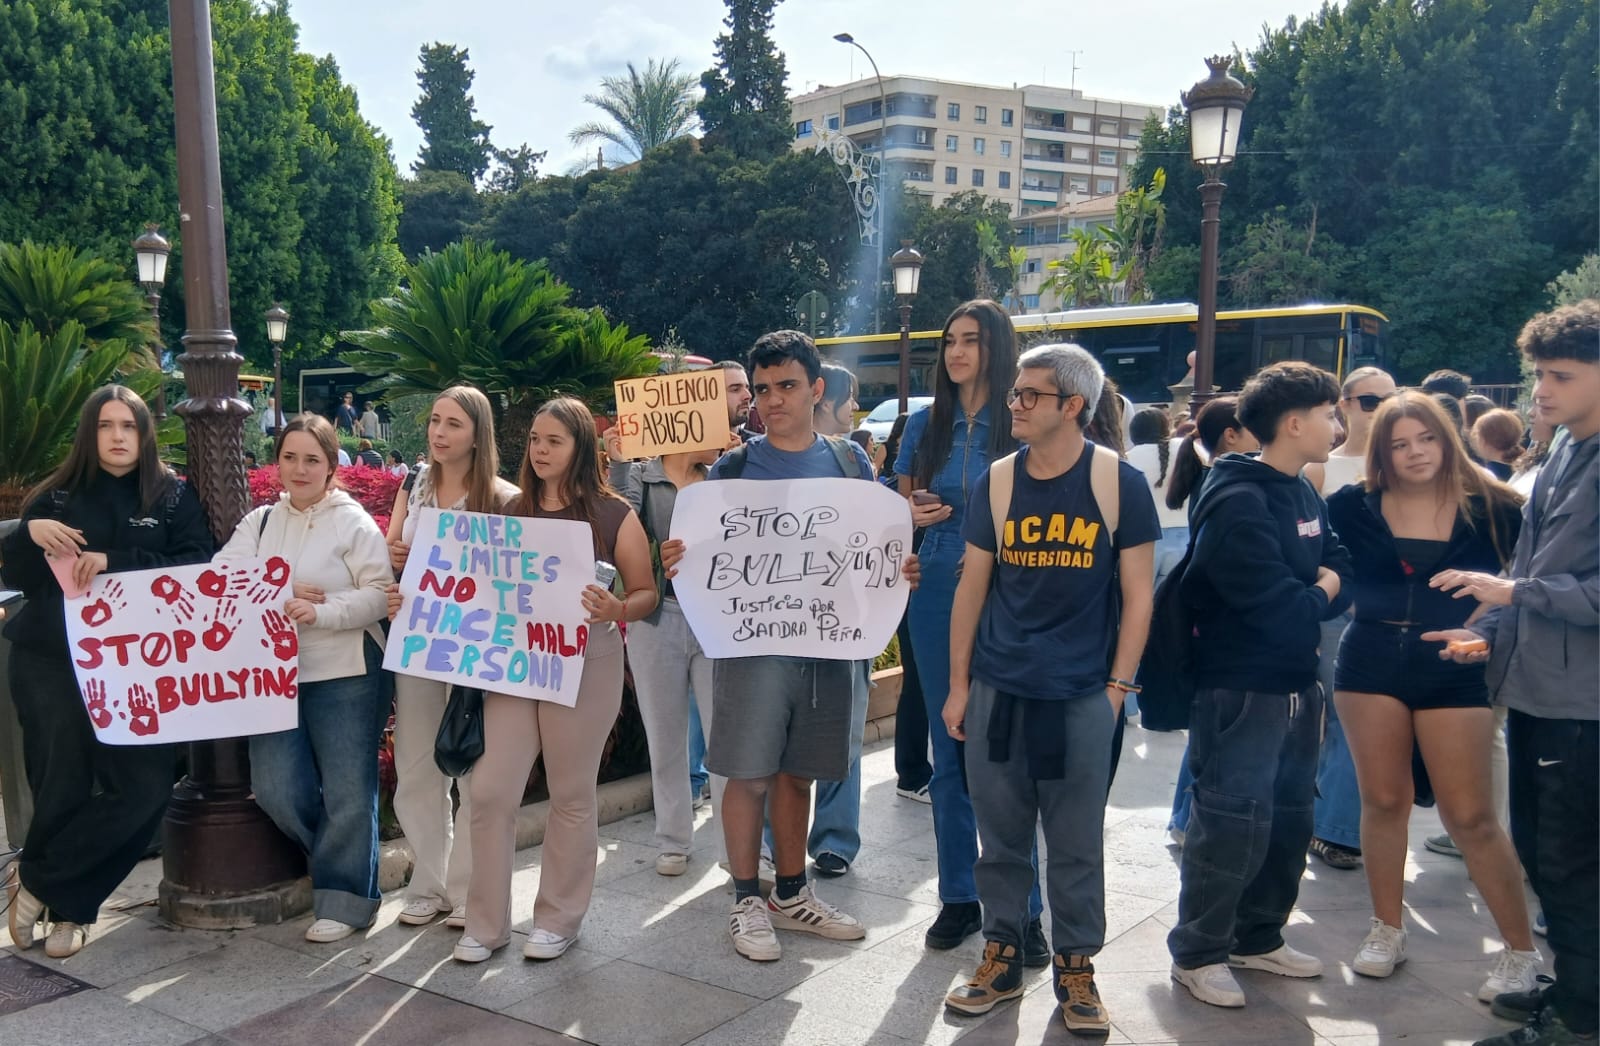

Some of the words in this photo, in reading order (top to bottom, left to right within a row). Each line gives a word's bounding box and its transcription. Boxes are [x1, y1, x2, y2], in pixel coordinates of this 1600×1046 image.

[616, 382, 635, 403] TU
[620, 413, 639, 437] ES
[642, 410, 704, 446] ABUSO
[436, 512, 523, 549] PONER
[719, 505, 840, 541] STOP
[1002, 547, 1093, 569] UNIVERSIDAD
[418, 569, 477, 603] NO
[491, 579, 534, 615] TE
[409, 596, 518, 647] HACE
[526, 621, 588, 657] MALA
[76, 629, 196, 669] STOP
[400, 634, 564, 692] PERSONA
